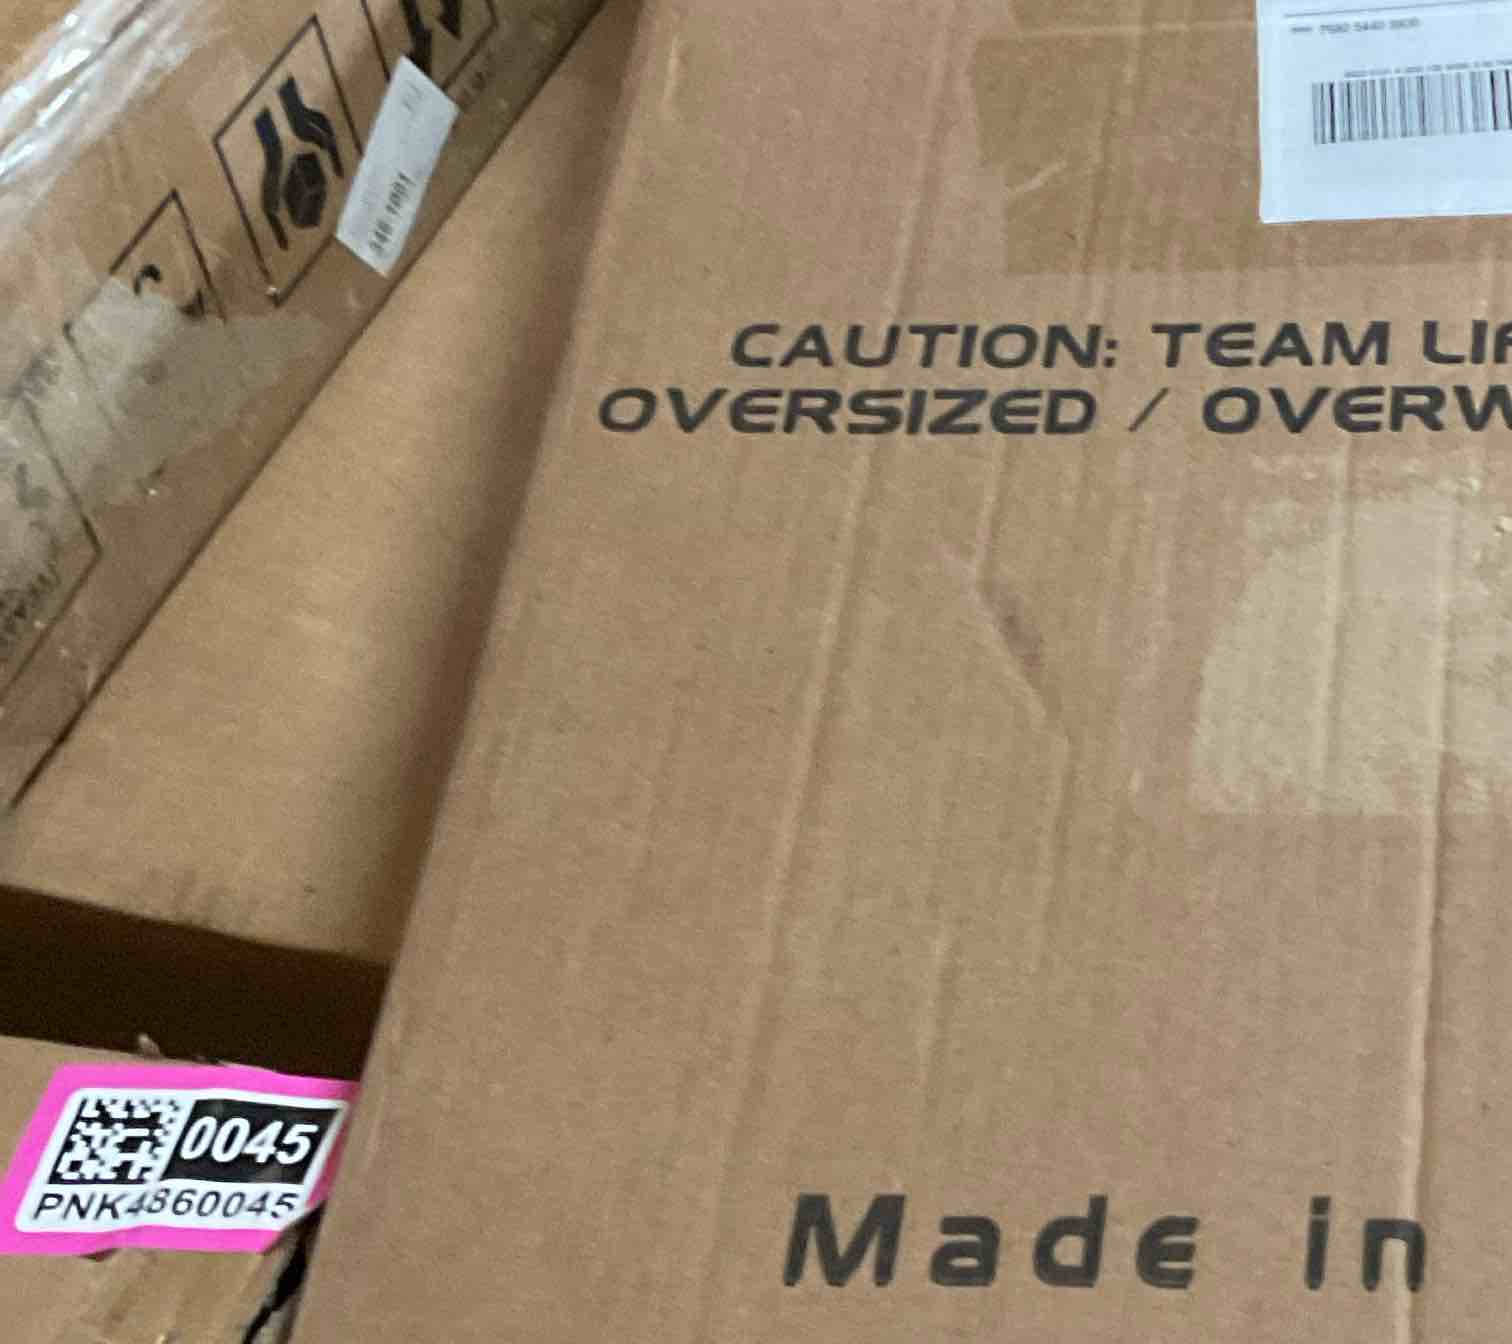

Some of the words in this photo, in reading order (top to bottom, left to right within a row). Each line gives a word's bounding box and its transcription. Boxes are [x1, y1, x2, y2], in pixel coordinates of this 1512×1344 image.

[730, 322, 1117, 369] CAUTION:
[1152, 321, 1391, 369] TEAM
[599, 386, 1097, 435] OVERSIZED
[179, 1115, 320, 1165] 0045
[33, 1188, 300, 1222] PNK4860045
[782, 1192, 1200, 1290] Made
[1303, 1194, 1427, 1292] in
